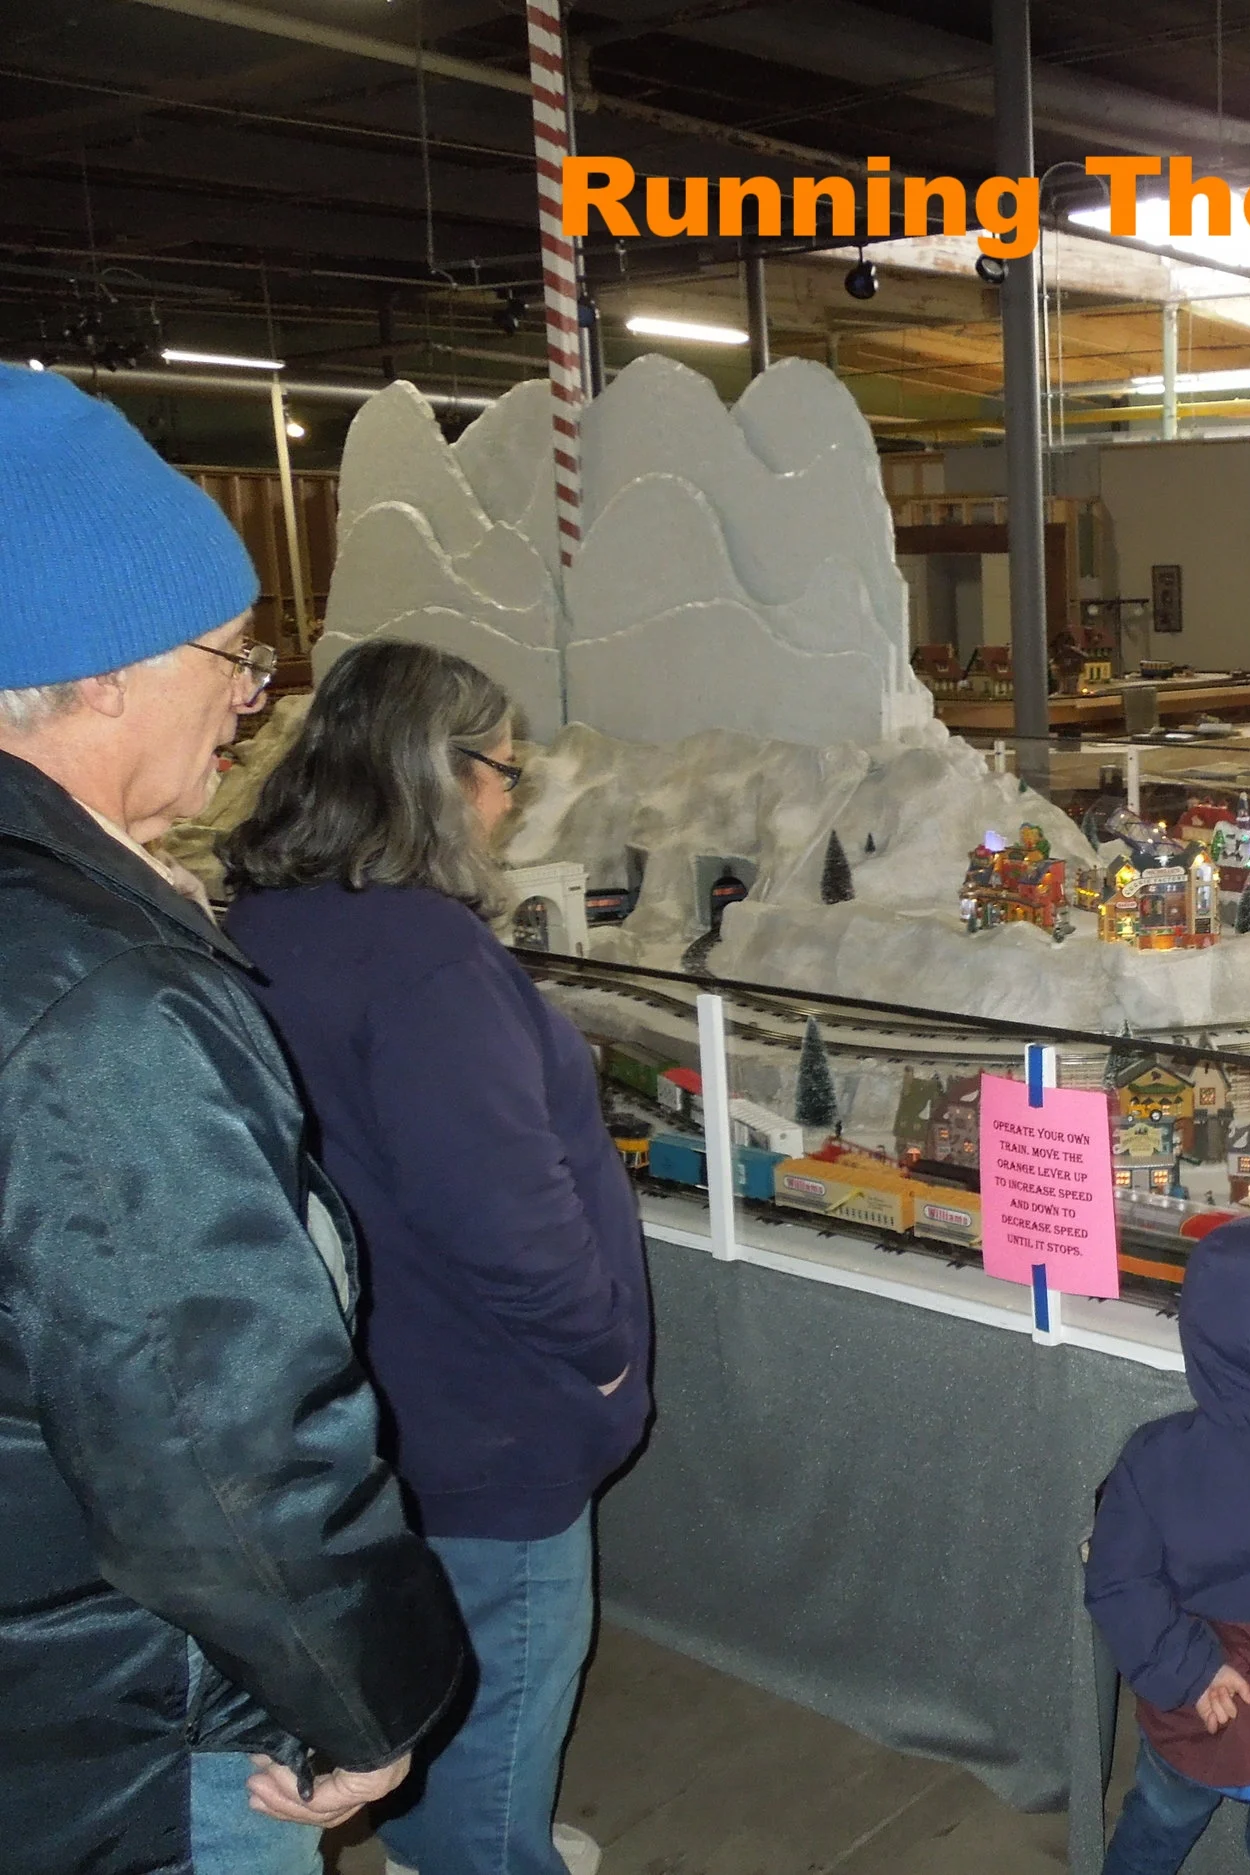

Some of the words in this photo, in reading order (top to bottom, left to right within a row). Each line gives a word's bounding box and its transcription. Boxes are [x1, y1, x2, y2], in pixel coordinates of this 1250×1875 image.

[993, 1120, 1035, 1137] OPERATE
[1037, 1128, 1065, 1142] YOUR
[1067, 1133, 1090, 1145] OWN
[999, 1140, 1030, 1155] TRAIN.
[1032, 1147, 1060, 1160] MOVE
[1062, 1152, 1083, 1163] THE
[997, 1159, 1035, 1175] ORANGE
[1038, 1167, 1071, 1181] LEVER
[1074, 1172, 1088, 1182] UP
[994, 1176, 1006, 1187] TO
[1008, 1179, 1056, 1197] INCREASE
[1058, 1189, 1093, 1202] SPEED
[927, 1206, 969, 1226] Williams
[1010, 1199, 1029, 1210] AND
[1031, 1203, 1060, 1216] DOWN
[1062, 1208, 1076, 1218] TO
[1001, 1214, 1052, 1234] DECREASE
[1054, 1225, 1088, 1239] SPEED
[1007, 1234, 1033, 1248] UNTIL
[1035, 1240, 1044, 1250] IT
[1047, 1242, 1084, 1257] STOPS.
